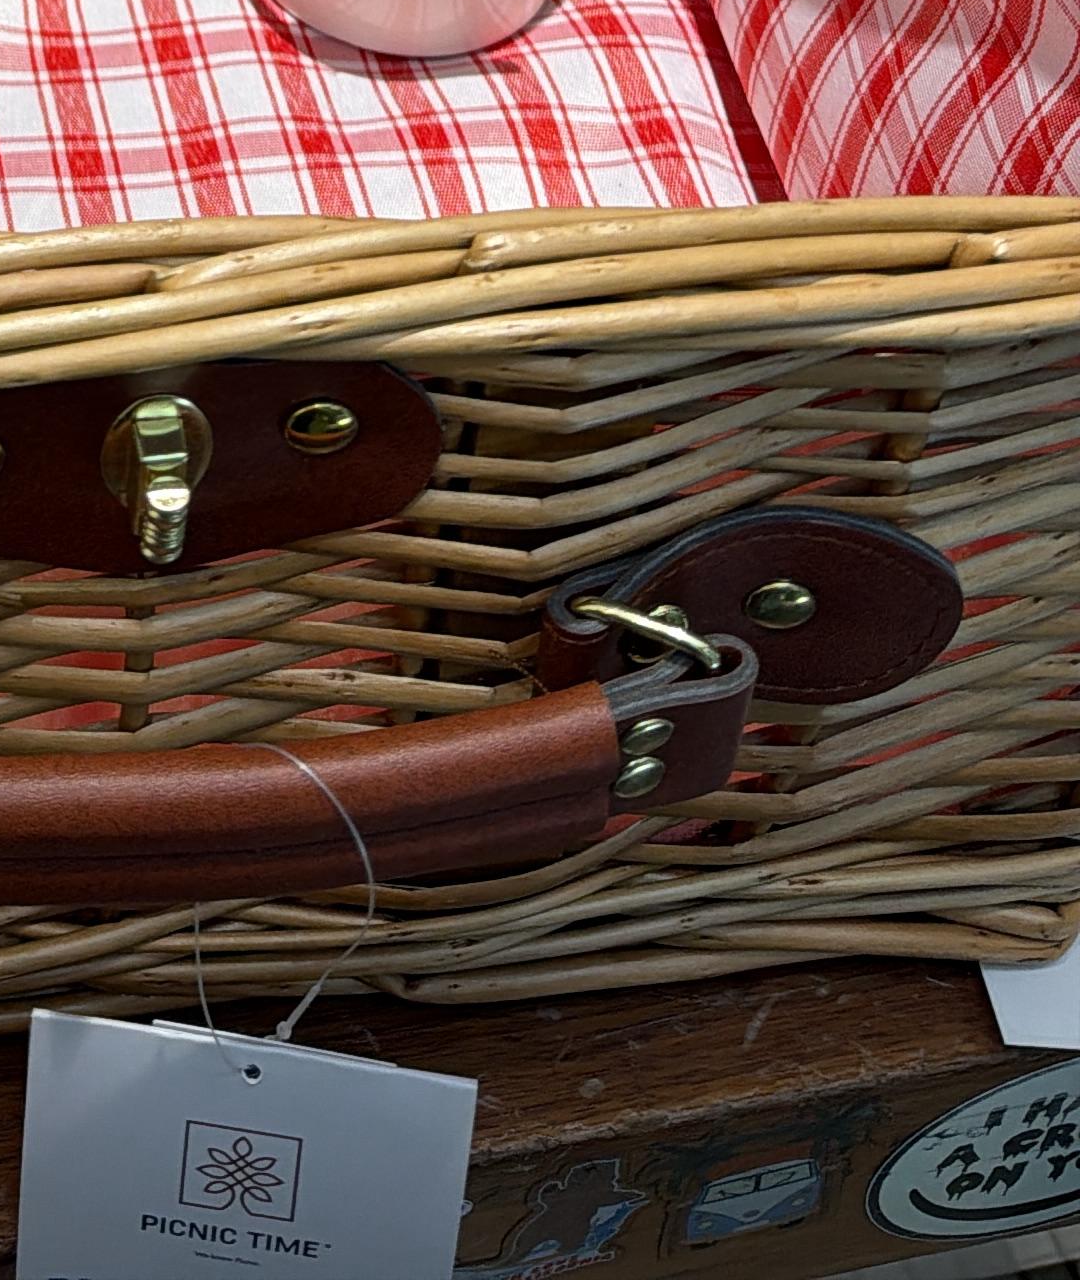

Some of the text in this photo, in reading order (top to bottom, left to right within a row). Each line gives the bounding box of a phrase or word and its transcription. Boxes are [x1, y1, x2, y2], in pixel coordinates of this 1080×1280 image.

[936, 1123, 1080, 1178] A CR
[945, 1161, 1029, 1201] ON
[141, 1214, 237, 1244] PICNIC
